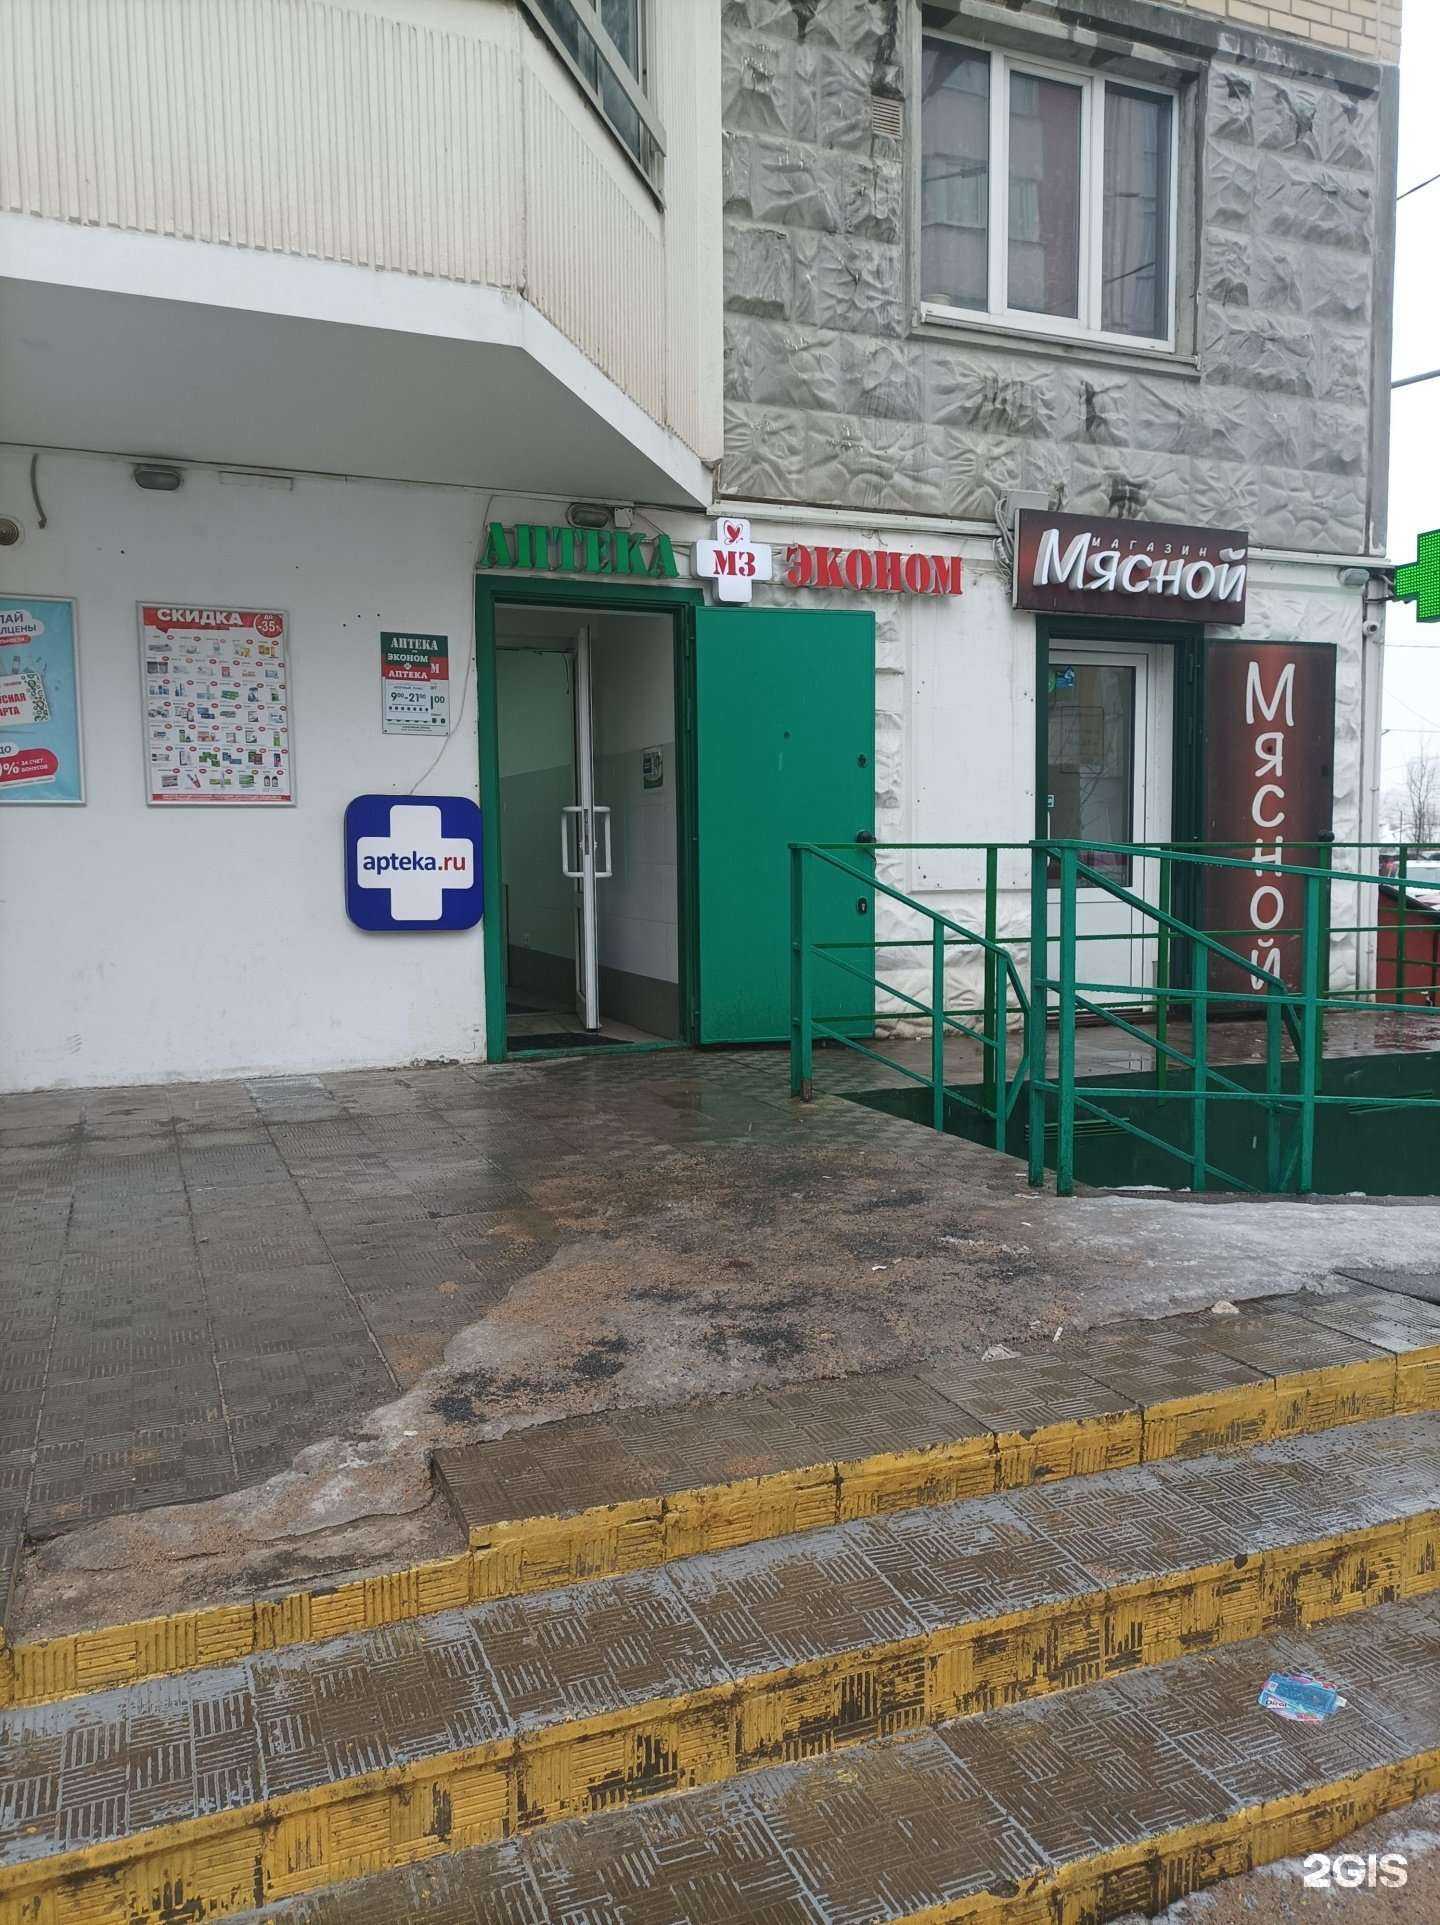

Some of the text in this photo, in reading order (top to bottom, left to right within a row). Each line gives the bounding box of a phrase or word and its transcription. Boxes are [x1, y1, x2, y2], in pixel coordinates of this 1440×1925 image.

[480, 522, 679, 578] АПТЕКА
[786, 543, 964, 596] ЭКОНОМ
[157, 608, 243, 625] СКИДКА
[391, 637, 439, 650] АПТЕКА
[387, 653, 429, 662] ЭКОНОМ
[388, 670, 428, 679] АПТЕКА
[363, 850, 466, 875] apteka.ru
